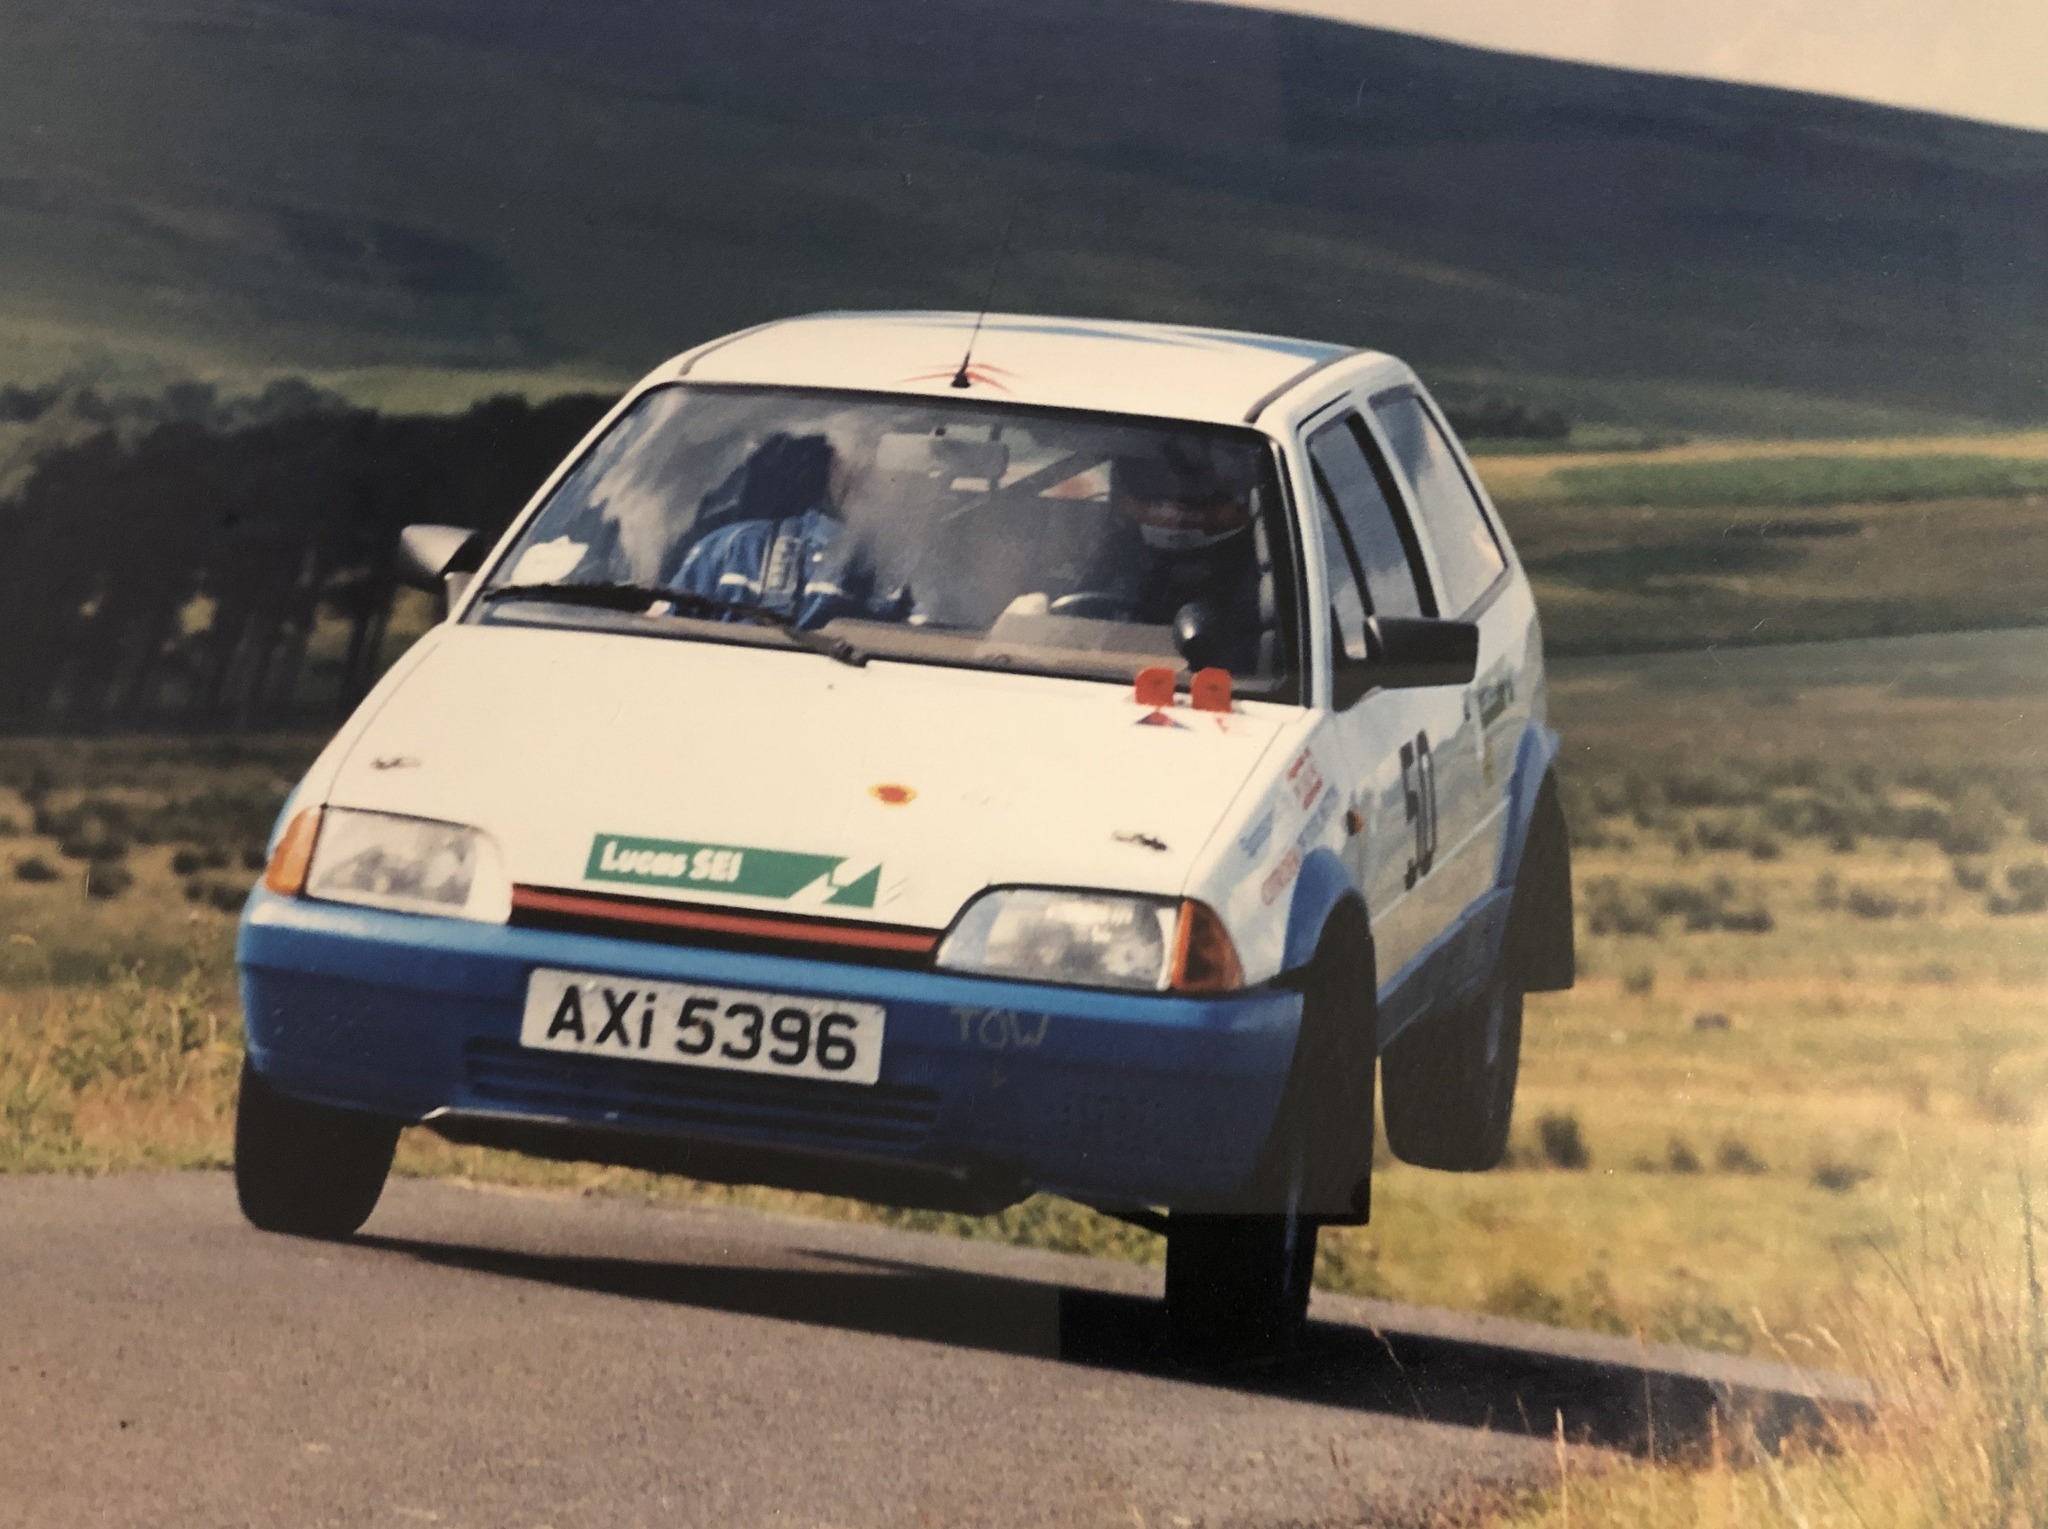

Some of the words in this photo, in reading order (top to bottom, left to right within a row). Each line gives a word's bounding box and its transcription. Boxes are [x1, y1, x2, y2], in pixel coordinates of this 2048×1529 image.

[1399, 729, 1437, 890] 50
[601, 840, 686, 879] Lucas
[547, 984, 655, 1050] AXi
[676, 998, 858, 1071] 5396
[951, 1005, 1049, 1049] TOW
